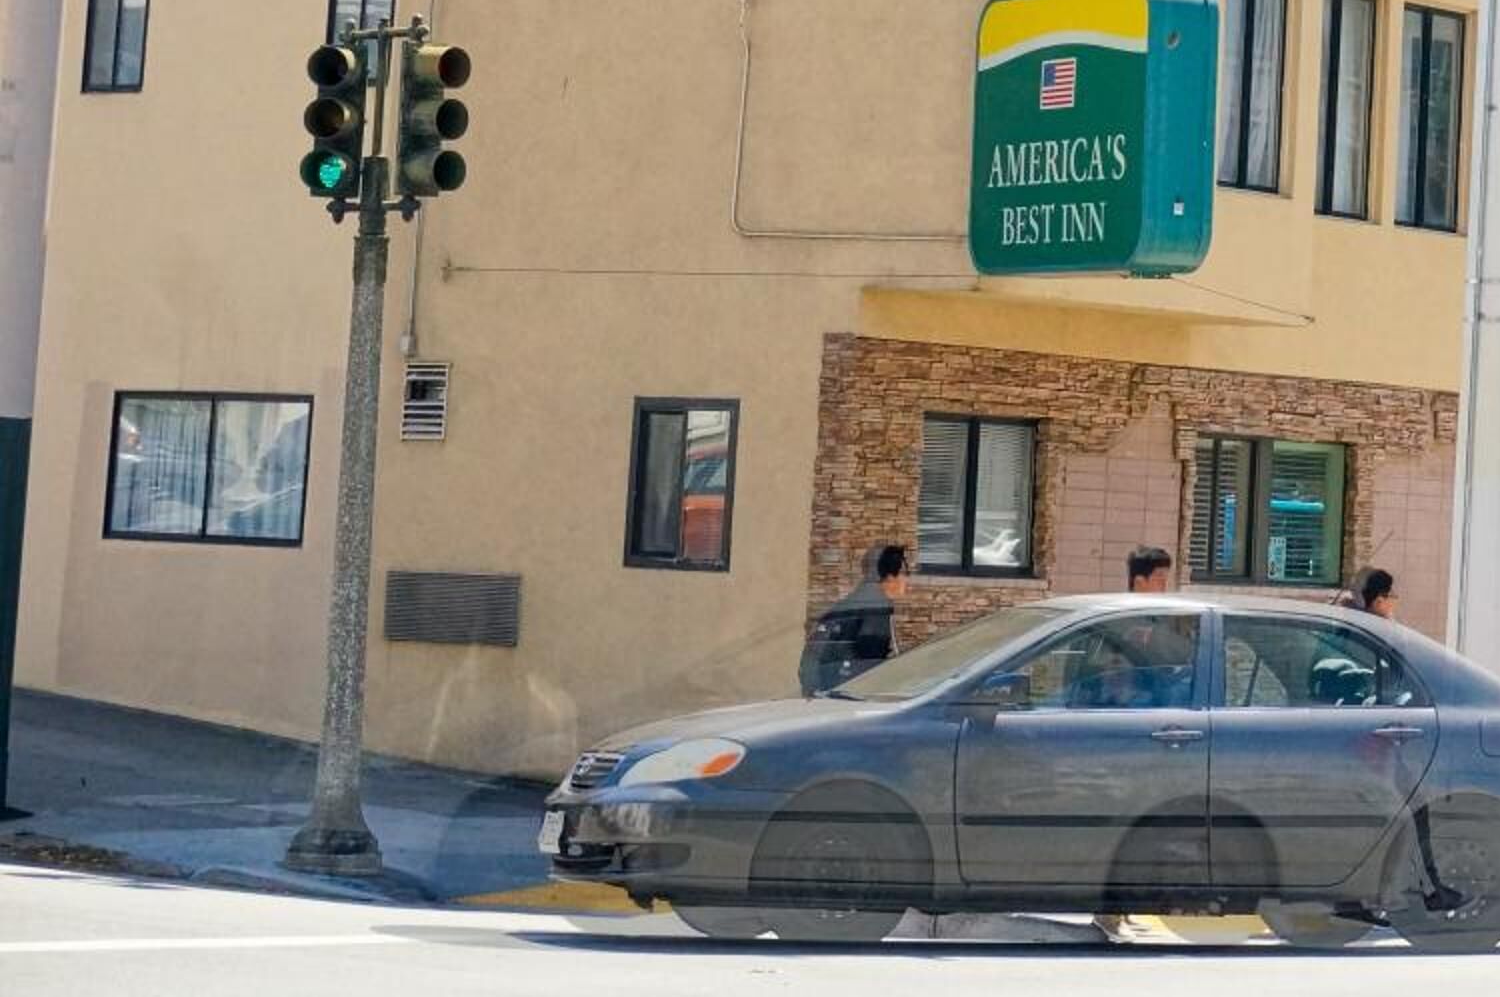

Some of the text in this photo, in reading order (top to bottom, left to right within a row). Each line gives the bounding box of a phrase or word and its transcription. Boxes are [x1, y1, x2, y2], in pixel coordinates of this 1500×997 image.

[988, 134, 1127, 188] AMERICA'S
[1001, 202, 1106, 246] BEST INN
